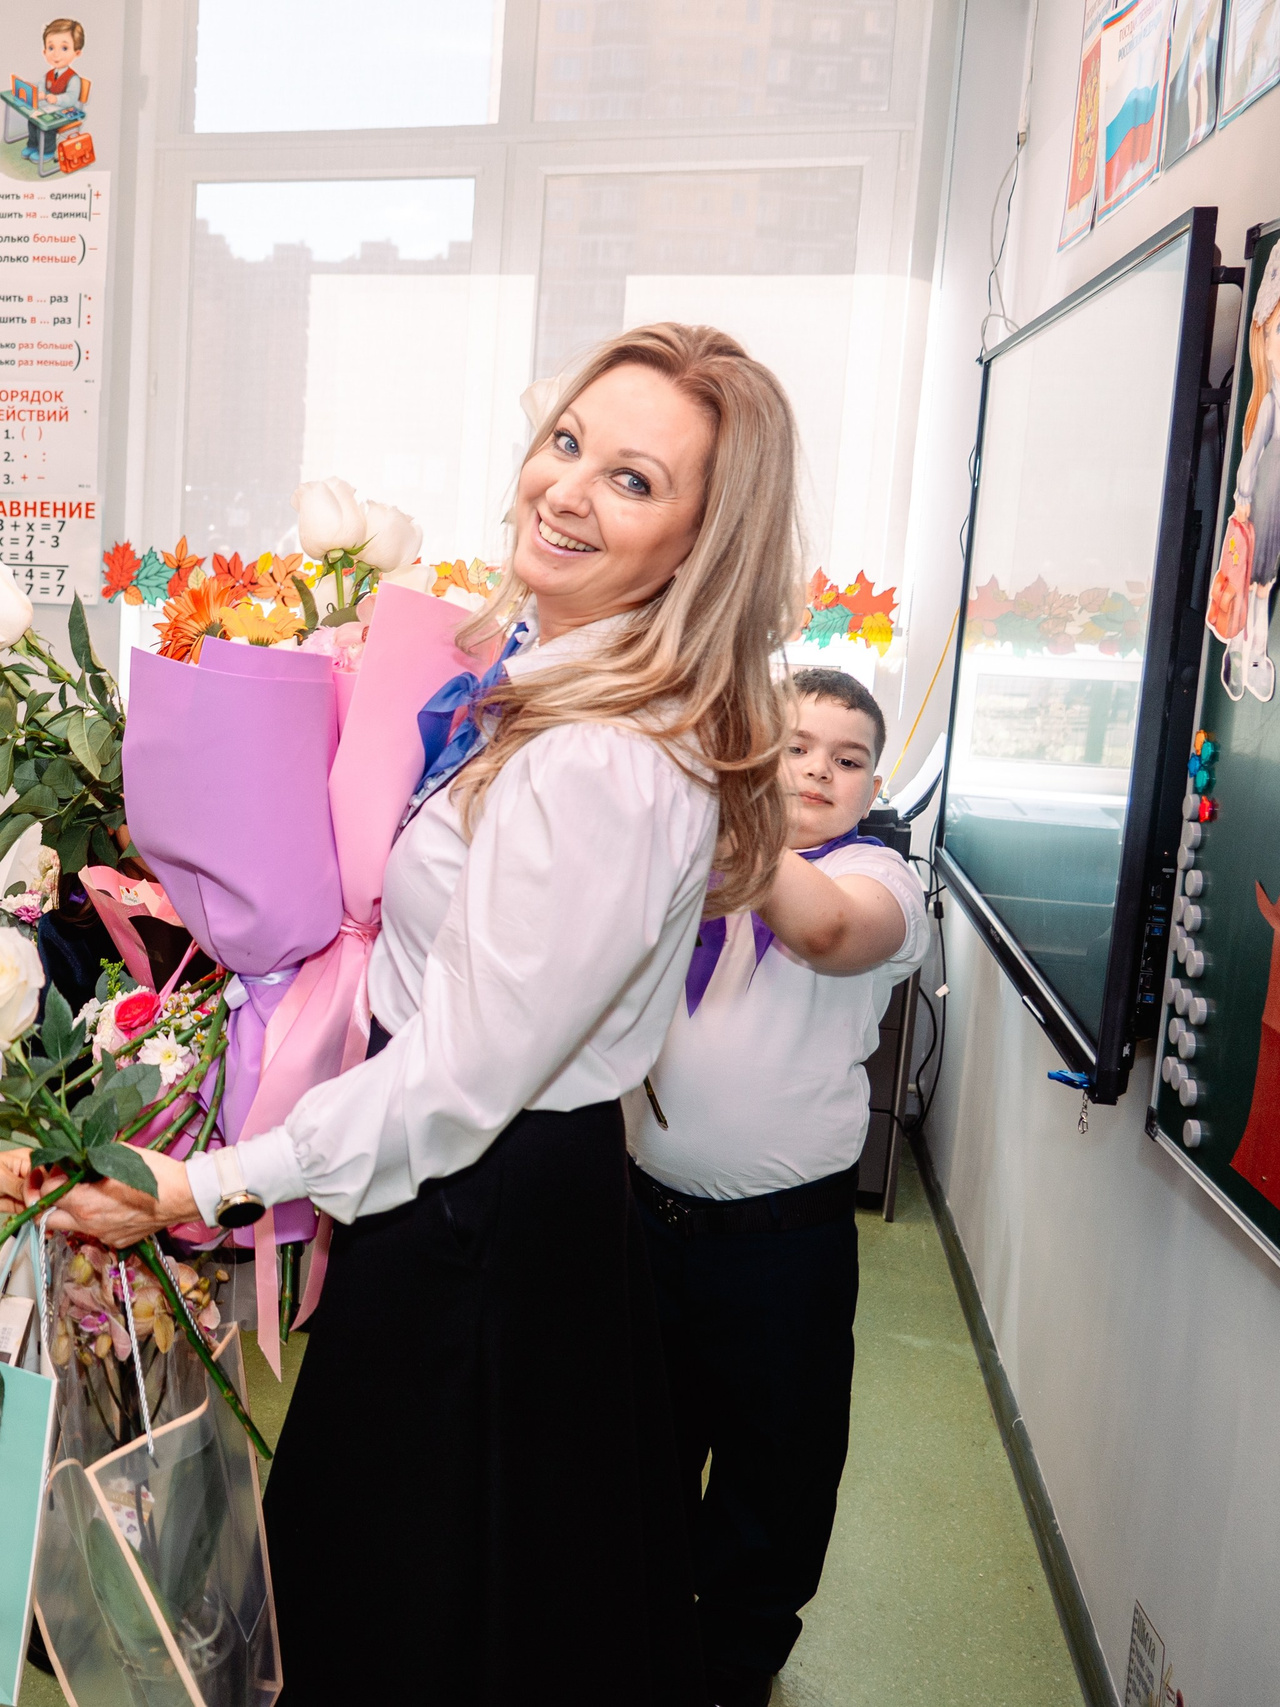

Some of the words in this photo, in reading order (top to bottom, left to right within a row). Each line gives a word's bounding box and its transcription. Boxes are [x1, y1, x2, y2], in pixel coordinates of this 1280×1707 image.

[50, 192, 86, 201] единиц
[33, 234, 76, 243] больше
[50, 295, 68, 305] раз
[53, 317, 71, 326] раз
[18, 342, 34, 351] раз
[37, 341, 73, 350] больше
[18, 359, 33, 368] раз
[37, 359, 74, 367] меньше
[4, 429, 15, 439] 1.
[3, 452, 14, 462] 2.
[3, 474, 14, 485] 3.
[58, 521, 66, 533] 7
[26, 535, 34, 547] 7
[51, 536, 60, 548] 3
[25, 551, 34, 562] 4
[25, 569, 34, 580] 4
[57, 570, 65, 581] 7
[56, 585, 65, 597] 7
